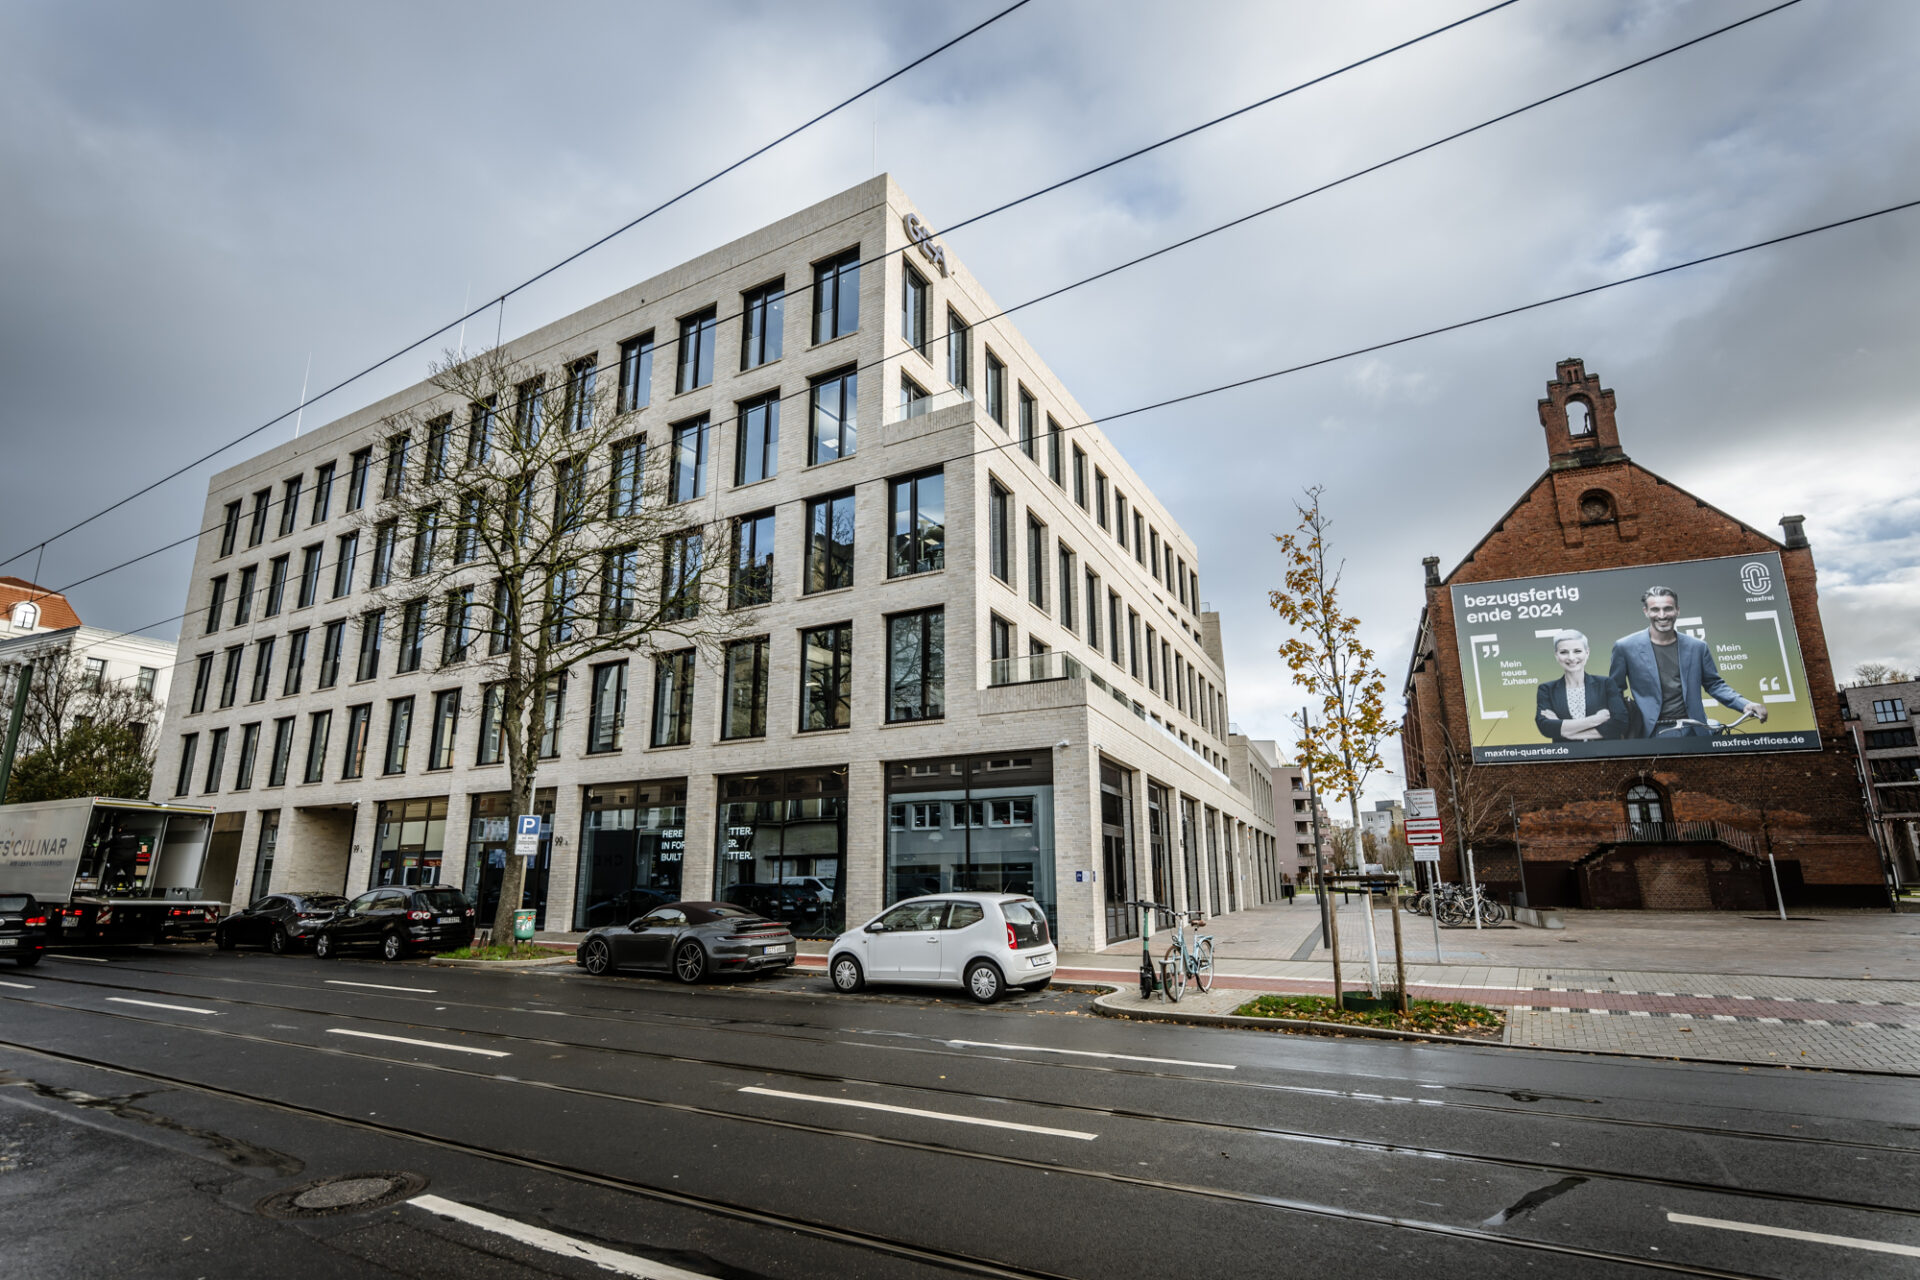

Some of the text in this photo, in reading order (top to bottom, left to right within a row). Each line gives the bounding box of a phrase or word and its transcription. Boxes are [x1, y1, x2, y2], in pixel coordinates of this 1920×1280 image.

[1464, 585, 1580, 608] bezugsfertig
[1745, 594, 1775, 603] maxfrei
[1466, 602, 1564, 623] ende 2024
[1716, 643, 1742, 652] Mein
[1718, 653, 1748, 661] neues
[1500, 660, 1522, 668] Mein
[1720, 662, 1743, 671] Büro
[1501, 669, 1528, 677] neues
[1502, 678, 1538, 686] Zuhause
[1712, 735, 1805, 748] maxfrei-offices.de
[1484, 747, 1569, 757] maxfrei-quartier.de
[522, 817, 536, 834] P
[662, 829, 683, 838] HERE
[554, 836, 563, 846] 99
[661, 841, 670, 850] IN
[13, 838, 68, 856] CULINAR
[661, 852, 683, 861] BUILT
